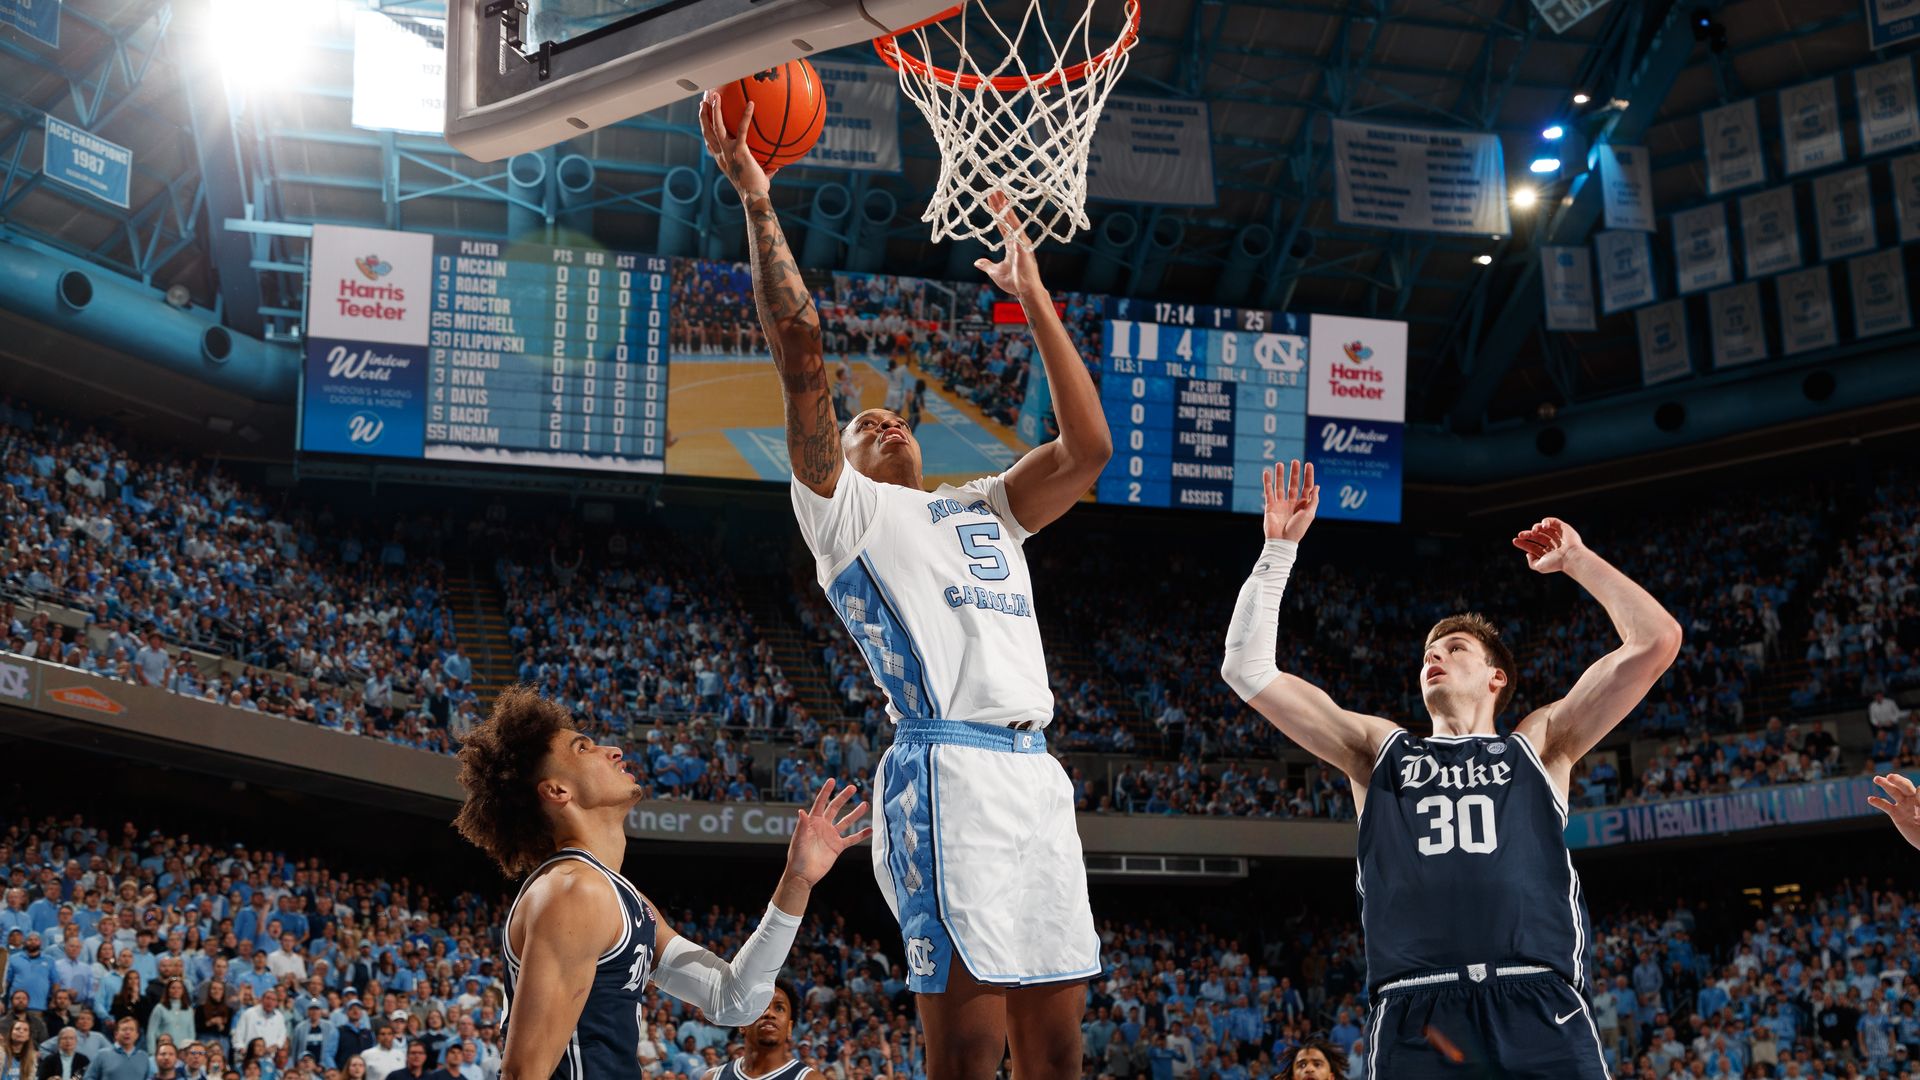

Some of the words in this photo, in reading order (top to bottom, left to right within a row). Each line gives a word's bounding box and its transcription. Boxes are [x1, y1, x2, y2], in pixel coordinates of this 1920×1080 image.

[49, 122, 71, 140] ACC
[71, 132, 129, 166] CHAMPIONS
[72, 149, 105, 175] 1987
[461, 241, 499, 257] PLAYER
[554, 250, 573, 264] PTS
[585, 251, 604, 266] REB
[617, 255, 636, 269] AST
[648, 258, 666, 272] FLS
[440, 257, 450, 271] 0
[457, 259, 506, 277] MCCAIN
[557, 266, 568, 283] 0
[588, 268, 599, 285] 0
[620, 271, 630, 288] 0
[650, 274, 661, 291] 0
[339, 279, 404, 302] Harris
[439, 276, 449, 290] 3
[456, 276, 497, 295] ROACH
[556, 284, 567, 301] 2
[588, 287, 598, 304] 0
[619, 289, 630, 306] 0
[651, 294, 659, 310] 1
[337, 298, 406, 320] Teeter
[438, 295, 448, 309] 5
[455, 294, 510, 314] PROCTOR
[556, 302, 566, 320] 0
[587, 305, 597, 322] 0
[619, 309, 627, 325] 1
[649, 311, 660, 328] 0
[1155, 303, 1195, 326] 17:14
[1245, 311, 1265, 331] 25
[432, 312, 453, 328] 25
[454, 313, 515, 333] MITCHELL
[555, 320, 566, 338] 0
[586, 323, 597, 341] 0
[618, 327, 626, 343] 1
[648, 328, 659, 345] 0
[327, 345, 410, 378] Window
[431, 331, 452, 347] 30
[453, 331, 525, 353] FILIPOWSKI
[554, 339, 565, 355] 2
[587, 342, 595, 358] 1
[617, 345, 628, 362] 0
[648, 346, 658, 364] 0
[1176, 328, 1192, 361] 4
[1222, 332, 1237, 365] 6
[435, 349, 445, 364] 2
[452, 350, 500, 369] CADEAU
[553, 357, 564, 374] 0
[585, 360, 596, 377] 0
[616, 363, 627, 380] 0
[647, 364, 658, 381] 0
[1114, 359, 1136, 374] FLS:
[1137, 361, 1143, 374] 1
[1166, 362, 1187, 378] TOL:
[1188, 364, 1196, 378] 4
[1216, 367, 1238, 381] TOL:
[1239, 368, 1247, 382] 4
[1268, 371, 1289, 385] FLS:
[1331, 364, 1383, 383] Harris
[322, 384, 372, 396] WINDOWS
[380, 387, 412, 399] SIDING
[434, 367, 444, 382] 3
[452, 368, 486, 386] RYAN
[552, 376, 563, 393] 0
[584, 378, 595, 395] 0
[614, 381, 626, 397] 2
[646, 382, 657, 399] 0
[1132, 377, 1145, 398] 0
[1189, 380, 1205, 391] PTS
[1264, 388, 1277, 408] 0
[1329, 380, 1386, 400] Teeter
[330, 395, 365, 406] DOORS
[367, 397, 374, 407] &
[375, 397, 404, 409] MORE
[434, 386, 444, 401] 4
[451, 386, 488, 405] DAVIS
[552, 395, 563, 410] 4
[584, 396, 594, 414] 0
[614, 399, 625, 416] 0
[645, 400, 656, 418] 0
[1181, 391, 1231, 407] TURNOVERS
[433, 405, 443, 421] 5
[450, 405, 490, 425] BACOT
[550, 414, 562, 430] 2
[584, 416, 592, 432] 1
[614, 417, 624, 435] 0
[644, 419, 655, 436] 0
[1131, 403, 1145, 424] 0
[1178, 405, 1197, 419] 2ND
[1198, 407, 1231, 422] CHANCE
[1264, 414, 1276, 434] 0
[1195, 419, 1213, 432] PTS
[426, 424, 447, 440] 55
[449, 424, 499, 443] INGRAM
[550, 431, 561, 449] 0
[583, 435, 591, 451] 1
[613, 437, 621, 453] 1
[644, 437, 655, 454] 0
[1130, 430, 1144, 450] 0
[1179, 431, 1228, 447] FASTBREAK
[1263, 440, 1276, 460] 2
[1194, 446, 1213, 459] PTS
[1321, 422, 1389, 452] Window
[1129, 456, 1143, 477] 0
[1172, 461, 1202, 478] BENCH
[1202, 464, 1234, 480] POINTS
[1127, 481, 1142, 503] 2
[1180, 488, 1223, 506] ASSISTS
[956, 522, 1010, 581] 5
[944, 585, 1032, 618] CAROLIN
[1400, 754, 1512, 790] Duke
[628, 807, 692, 833] tner
[699, 807, 734, 834] of
[1416, 795, 1498, 856] 30
